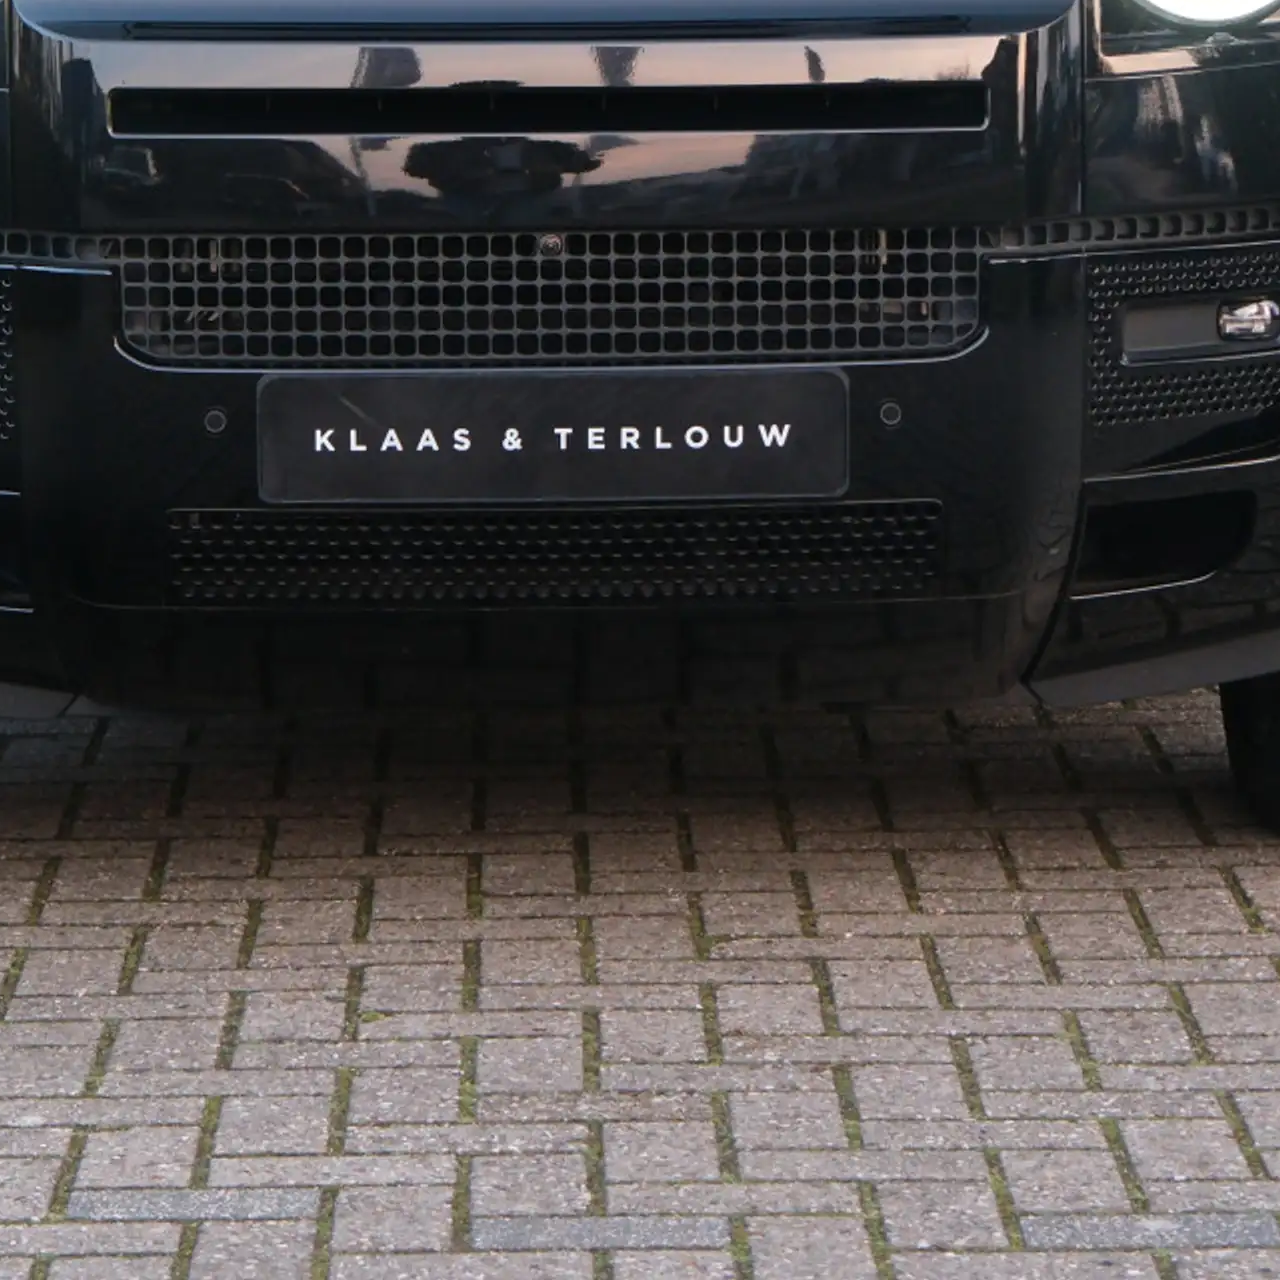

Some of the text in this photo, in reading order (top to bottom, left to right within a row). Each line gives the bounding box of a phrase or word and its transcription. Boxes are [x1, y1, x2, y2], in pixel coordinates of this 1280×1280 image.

[314, 423, 791, 452] KLAAS & TERLOUW
